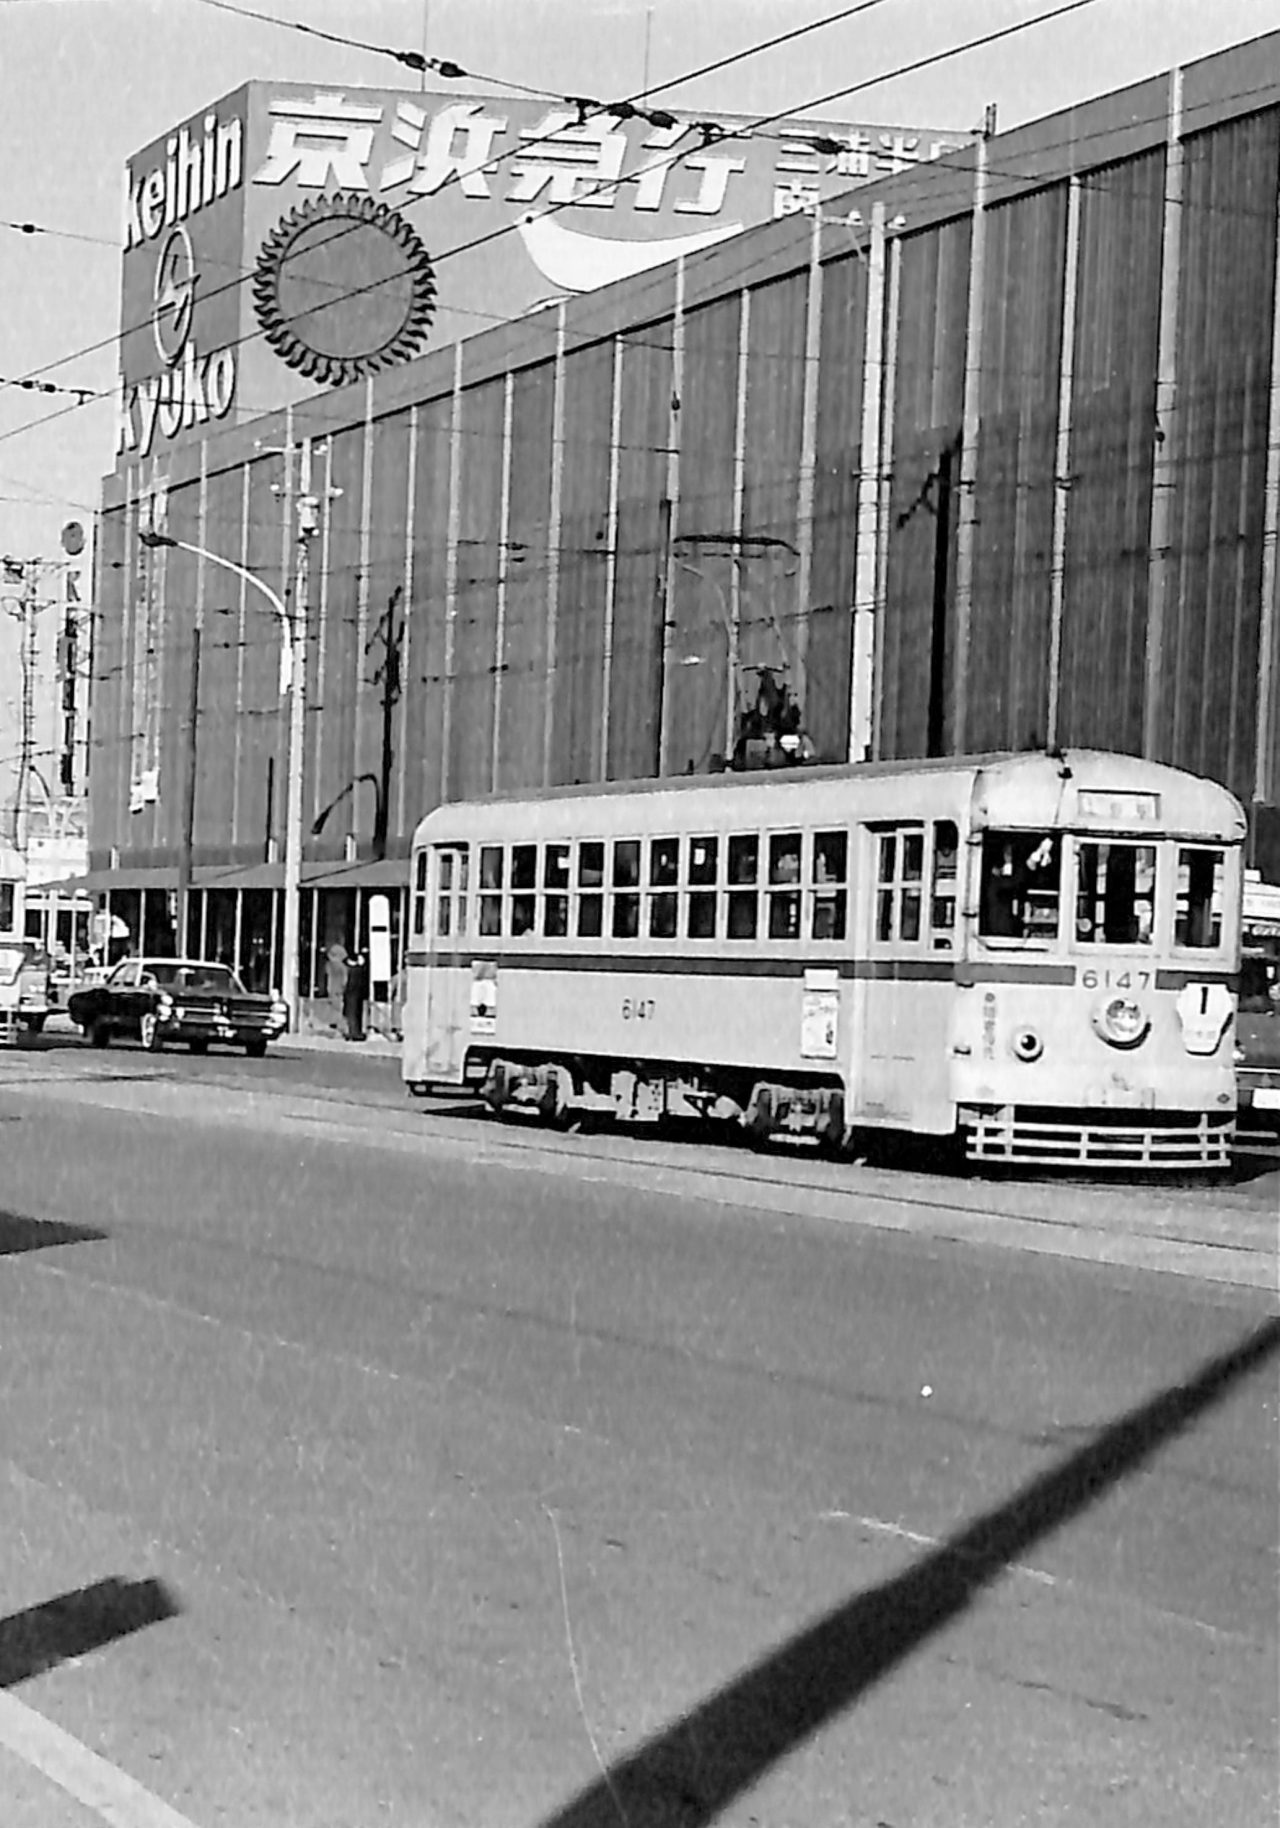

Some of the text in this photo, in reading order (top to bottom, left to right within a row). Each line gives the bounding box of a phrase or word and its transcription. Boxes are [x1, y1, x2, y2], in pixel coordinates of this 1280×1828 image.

[252, 91, 750, 214] 京浜急行
[774, 126, 968, 178] 三浦半
[1081, 968, 1151, 990] 6147
[622, 998, 656, 1020] 6147
[1200, 985, 1209, 1015] 1
